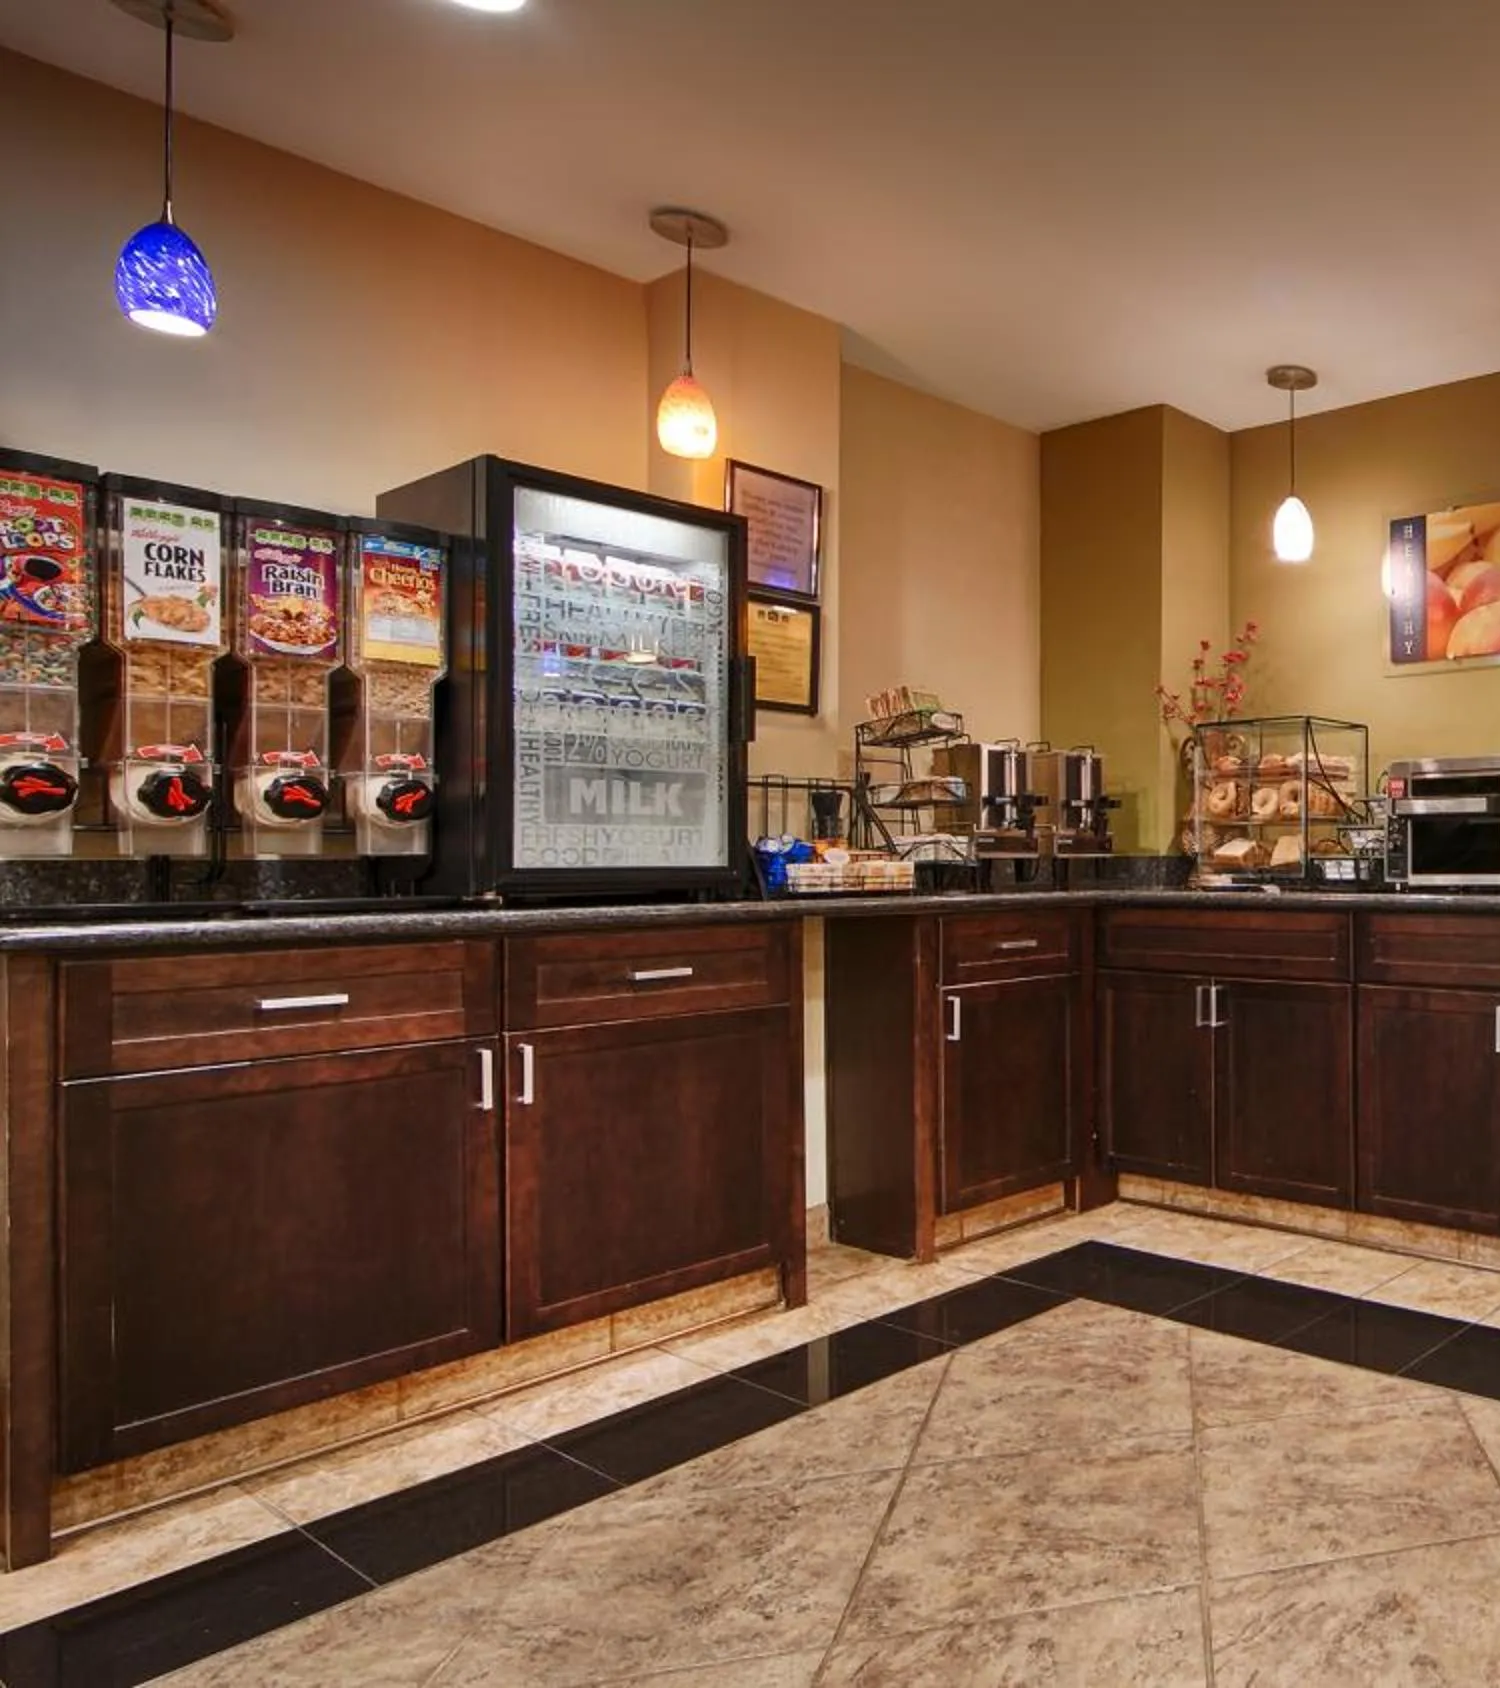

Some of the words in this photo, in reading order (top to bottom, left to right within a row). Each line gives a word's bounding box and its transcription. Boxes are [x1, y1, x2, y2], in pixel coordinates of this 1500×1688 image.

[1, 531, 74, 549] LOOPS
[144, 542, 205, 567] CORN
[144, 561, 206, 583] FLAKES
[263, 565, 324, 588] Raisin
[271, 581, 319, 598] Bran
[1403, 524, 1414, 655] HETHY
[611, 749, 704, 769] YOGURT
[520, 736, 541, 826] HEALTHY
[569, 777, 684, 817] MILK
[520, 826, 599, 846] FRESH
[600, 826, 703, 848] YOGURT
